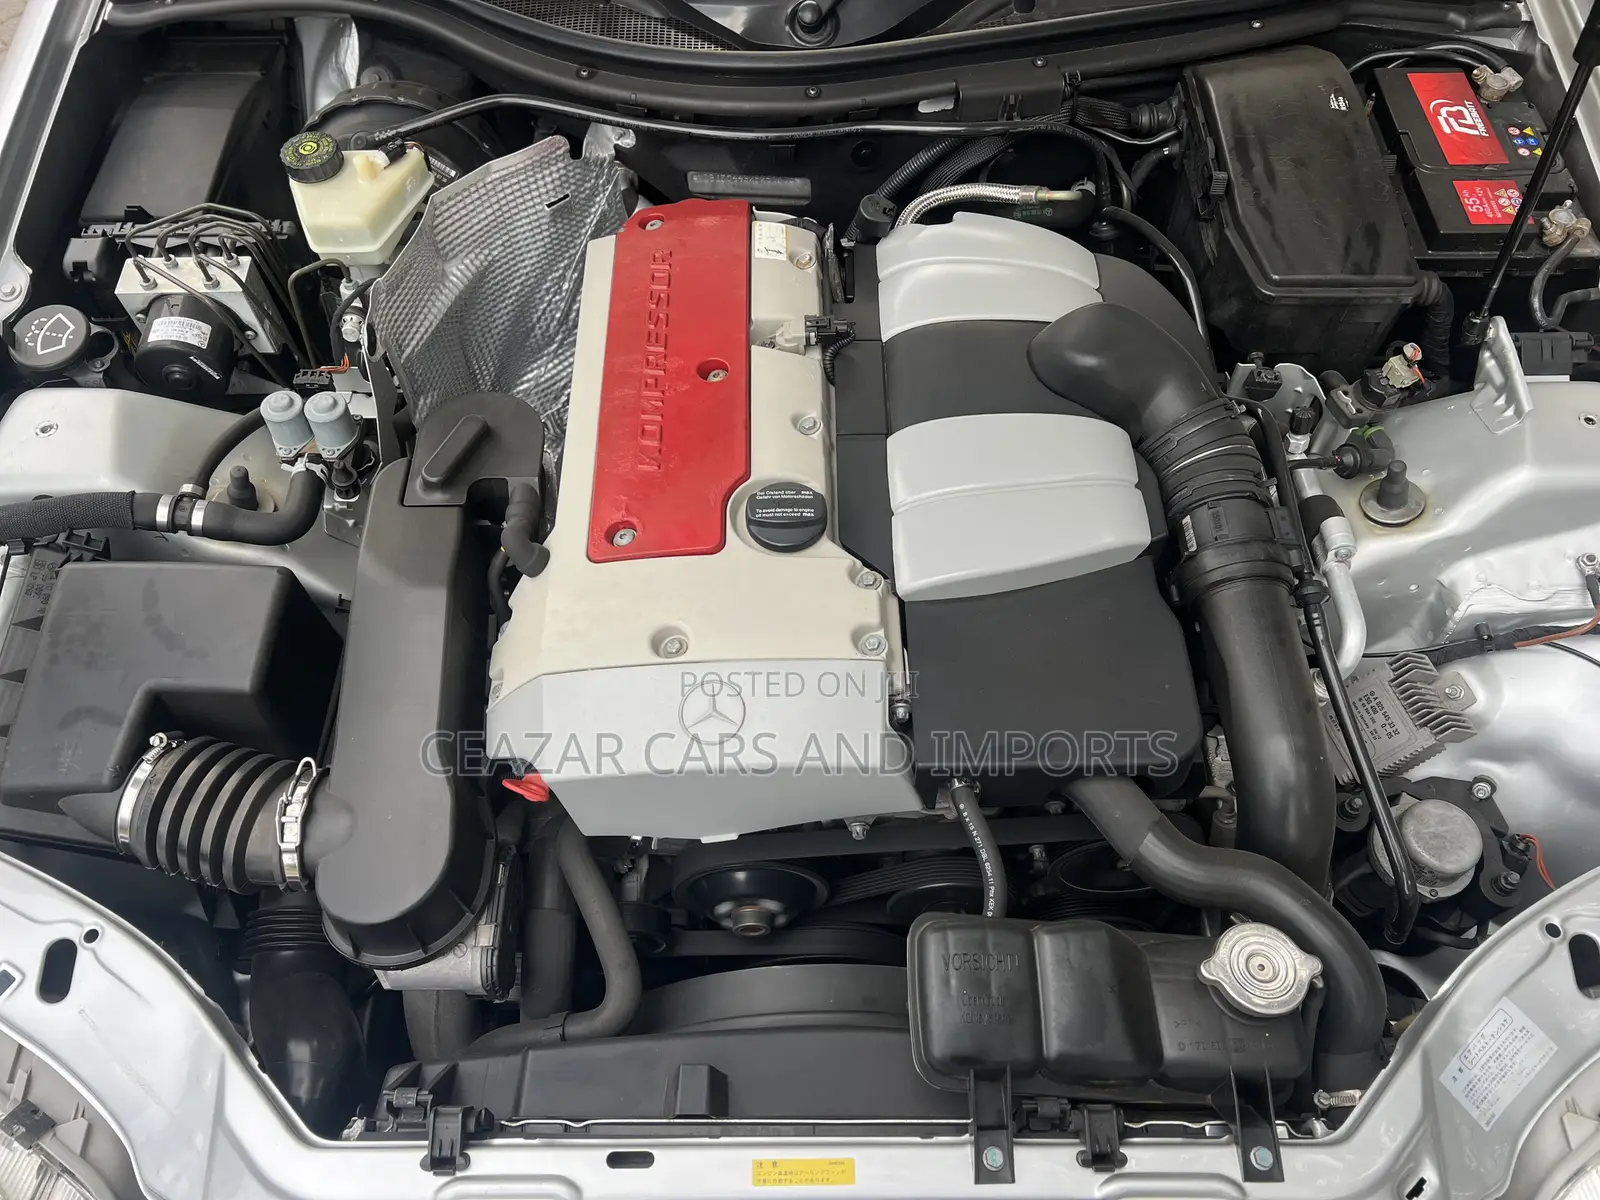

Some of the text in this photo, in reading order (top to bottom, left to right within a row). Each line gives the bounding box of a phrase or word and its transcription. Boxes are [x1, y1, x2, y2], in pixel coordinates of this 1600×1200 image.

[1466, 197, 1483, 213] 55
[637, 250, 672, 471] KOMPRESSOR
[1374, 700, 1385, 712] 025
[1380, 709, 1391, 722] 545
[1386, 719, 1396, 729] 33
[1391, 727, 1400, 736] 32
[968, 822, 975, 831] 15
[974, 836, 983, 847] 271
